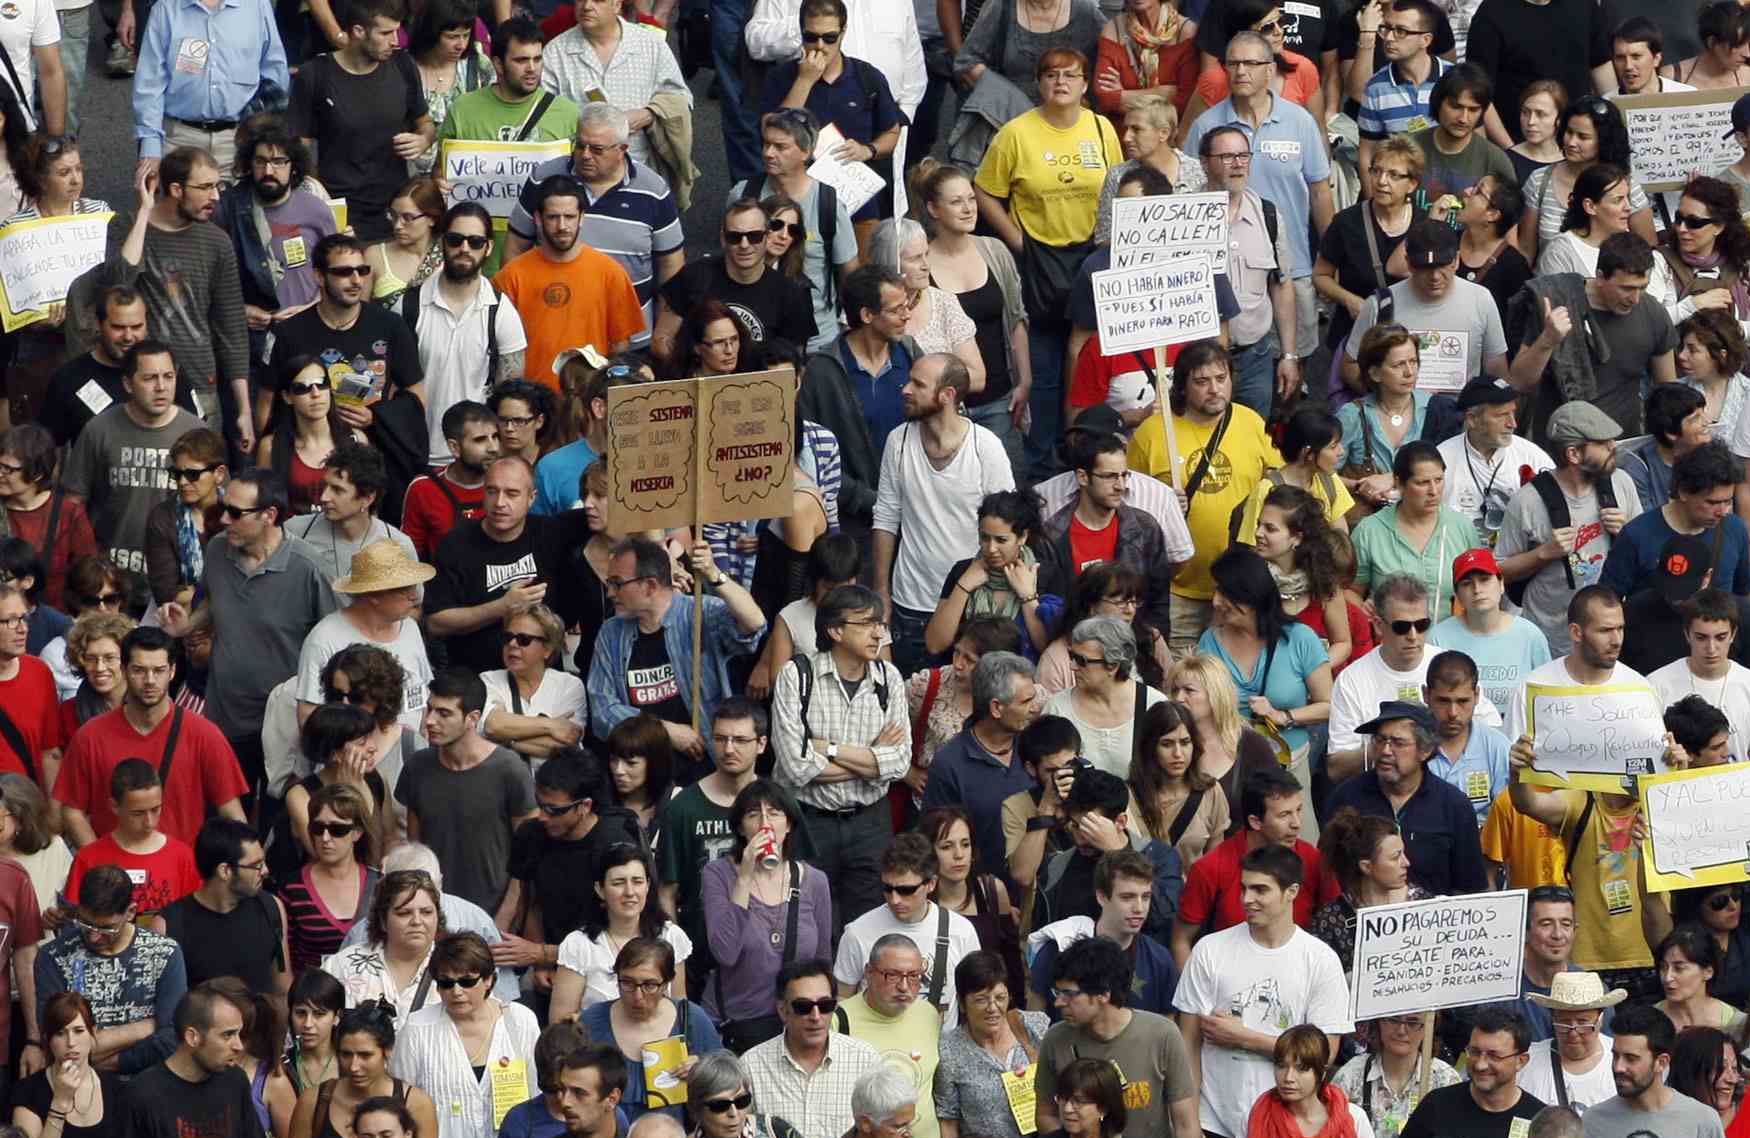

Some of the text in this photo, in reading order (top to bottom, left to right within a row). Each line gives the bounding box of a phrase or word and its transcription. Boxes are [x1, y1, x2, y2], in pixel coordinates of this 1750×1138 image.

[1138, 202, 1229, 225] NOSALTRES
[1114, 223, 1223, 248] NO CALLEM
[1099, 279, 1122, 298] NO
[1178, 311, 1212, 328] RATO
[648, 404, 695, 425] SISTEMA
[714, 443, 784, 463] ANTISISTEMA
[735, 465, 774, 484] ¿NO?
[629, 475, 675, 495] MISERIA
[1363, 907, 1497, 943] NO PAGAREMOS
[1401, 934, 1423, 951] SU
[1365, 947, 1444, 973] RESCATE
[1374, 965, 1434, 984] SANIDAD
